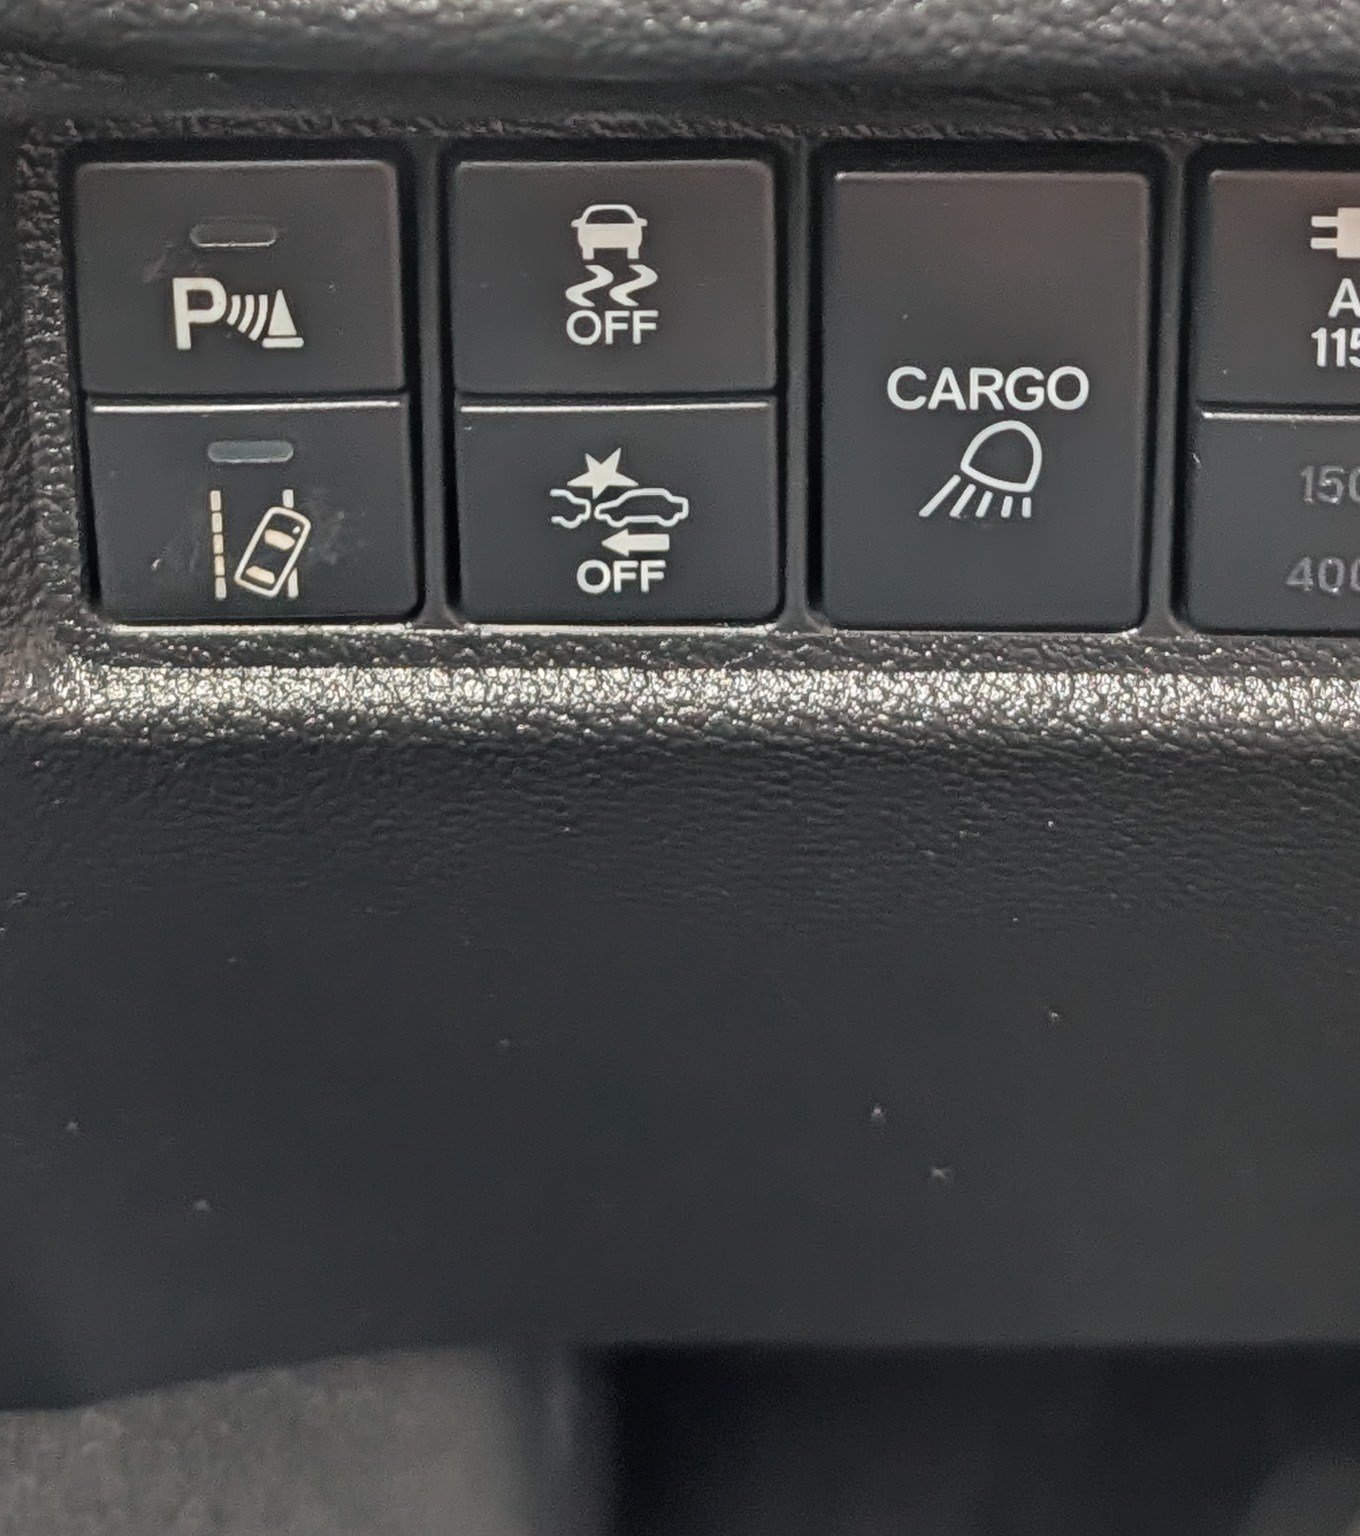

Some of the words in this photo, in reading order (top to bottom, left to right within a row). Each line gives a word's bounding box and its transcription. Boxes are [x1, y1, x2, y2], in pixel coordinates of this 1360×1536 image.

[171, 277, 227, 350] P
[566, 310, 659, 345] OFF
[886, 366, 1089, 412] CARGO
[576, 560, 666, 594] OFF
